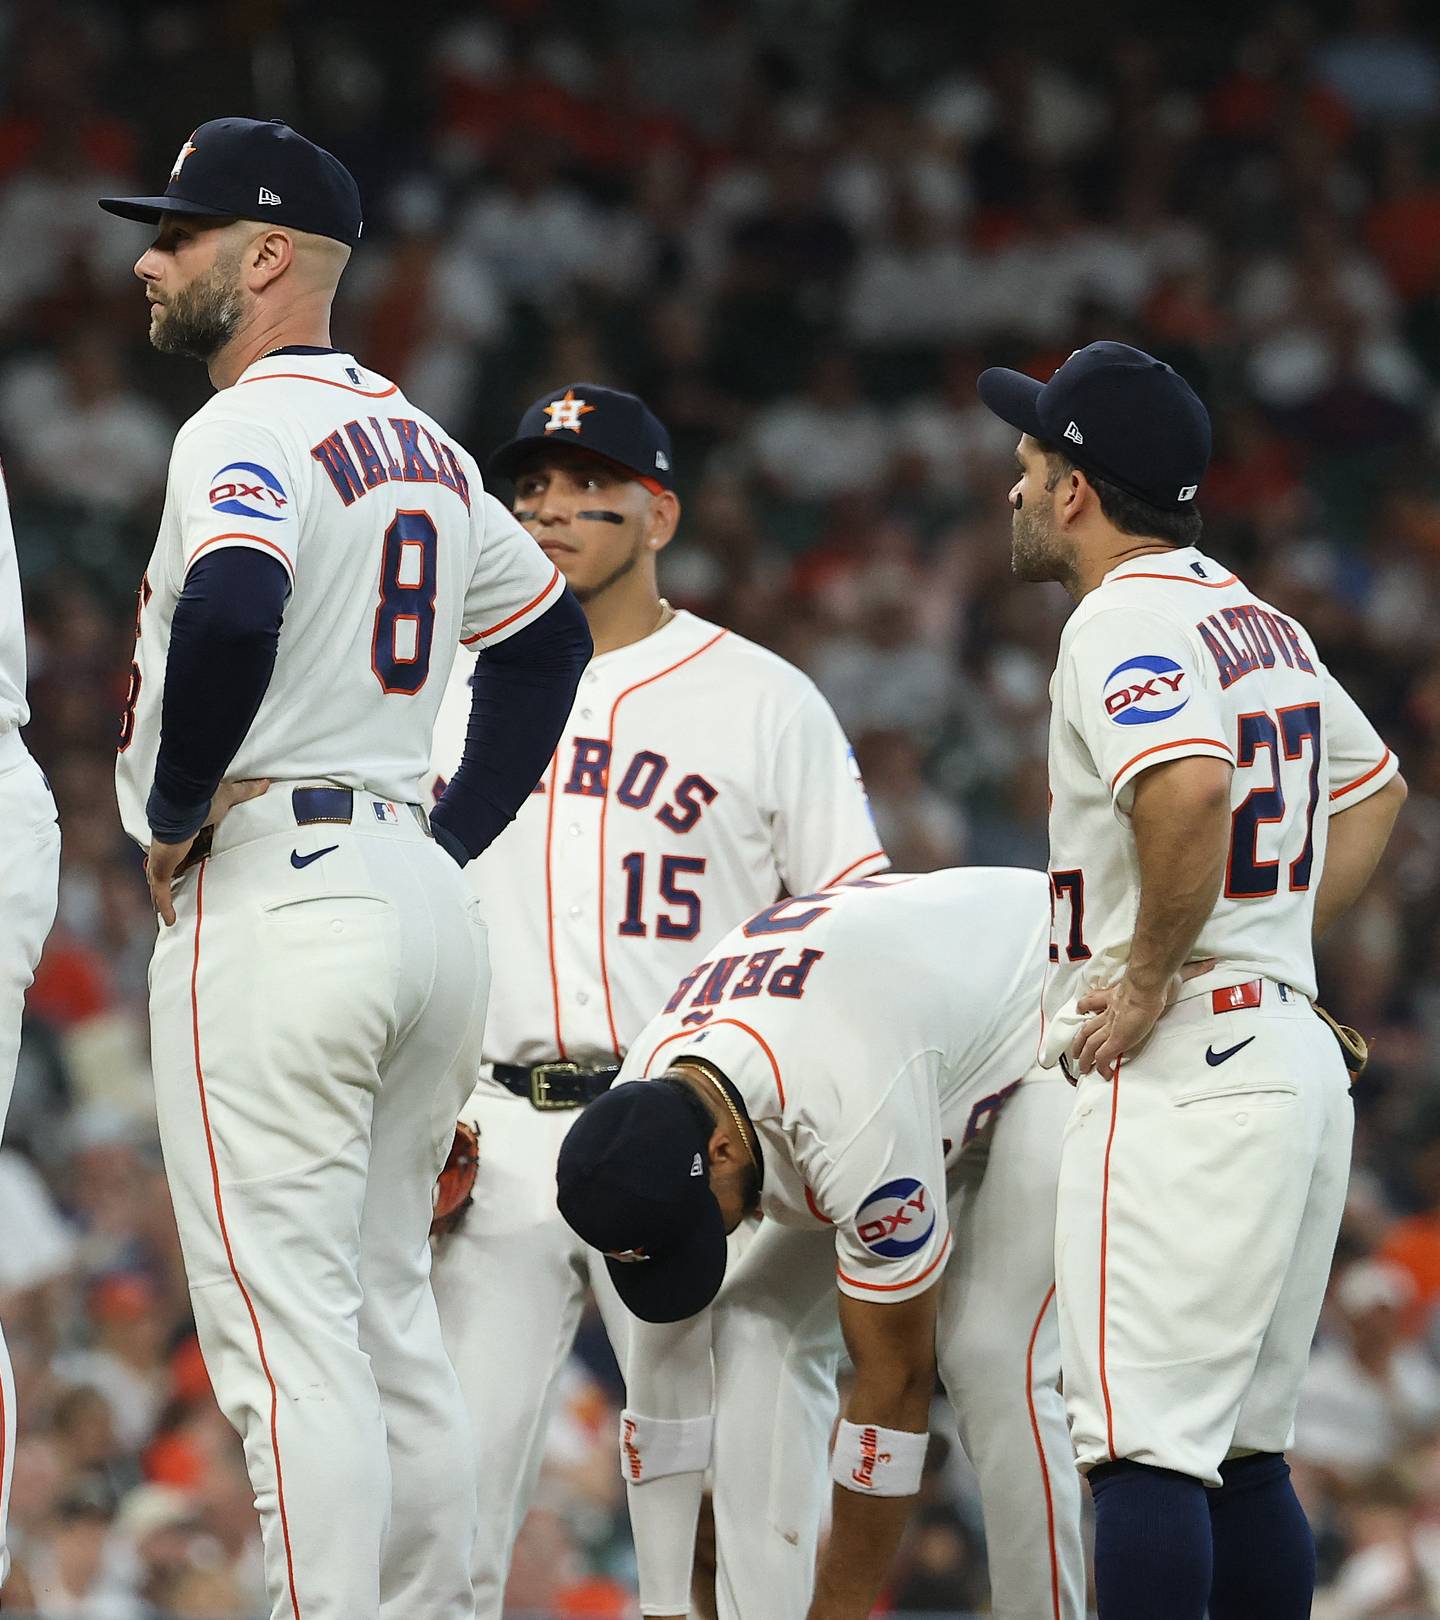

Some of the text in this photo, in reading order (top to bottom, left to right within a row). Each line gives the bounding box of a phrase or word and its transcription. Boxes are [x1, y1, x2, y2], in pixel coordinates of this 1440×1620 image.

[209, 483, 288, 509] OXY
[371, 509, 439, 696] 8
[1104, 672, 1186, 716] OXY
[1223, 702, 1321, 899] 27
[617, 851, 707, 942] 15
[1049, 869, 1093, 964] 7
[857, 1186, 926, 1243] OXY
